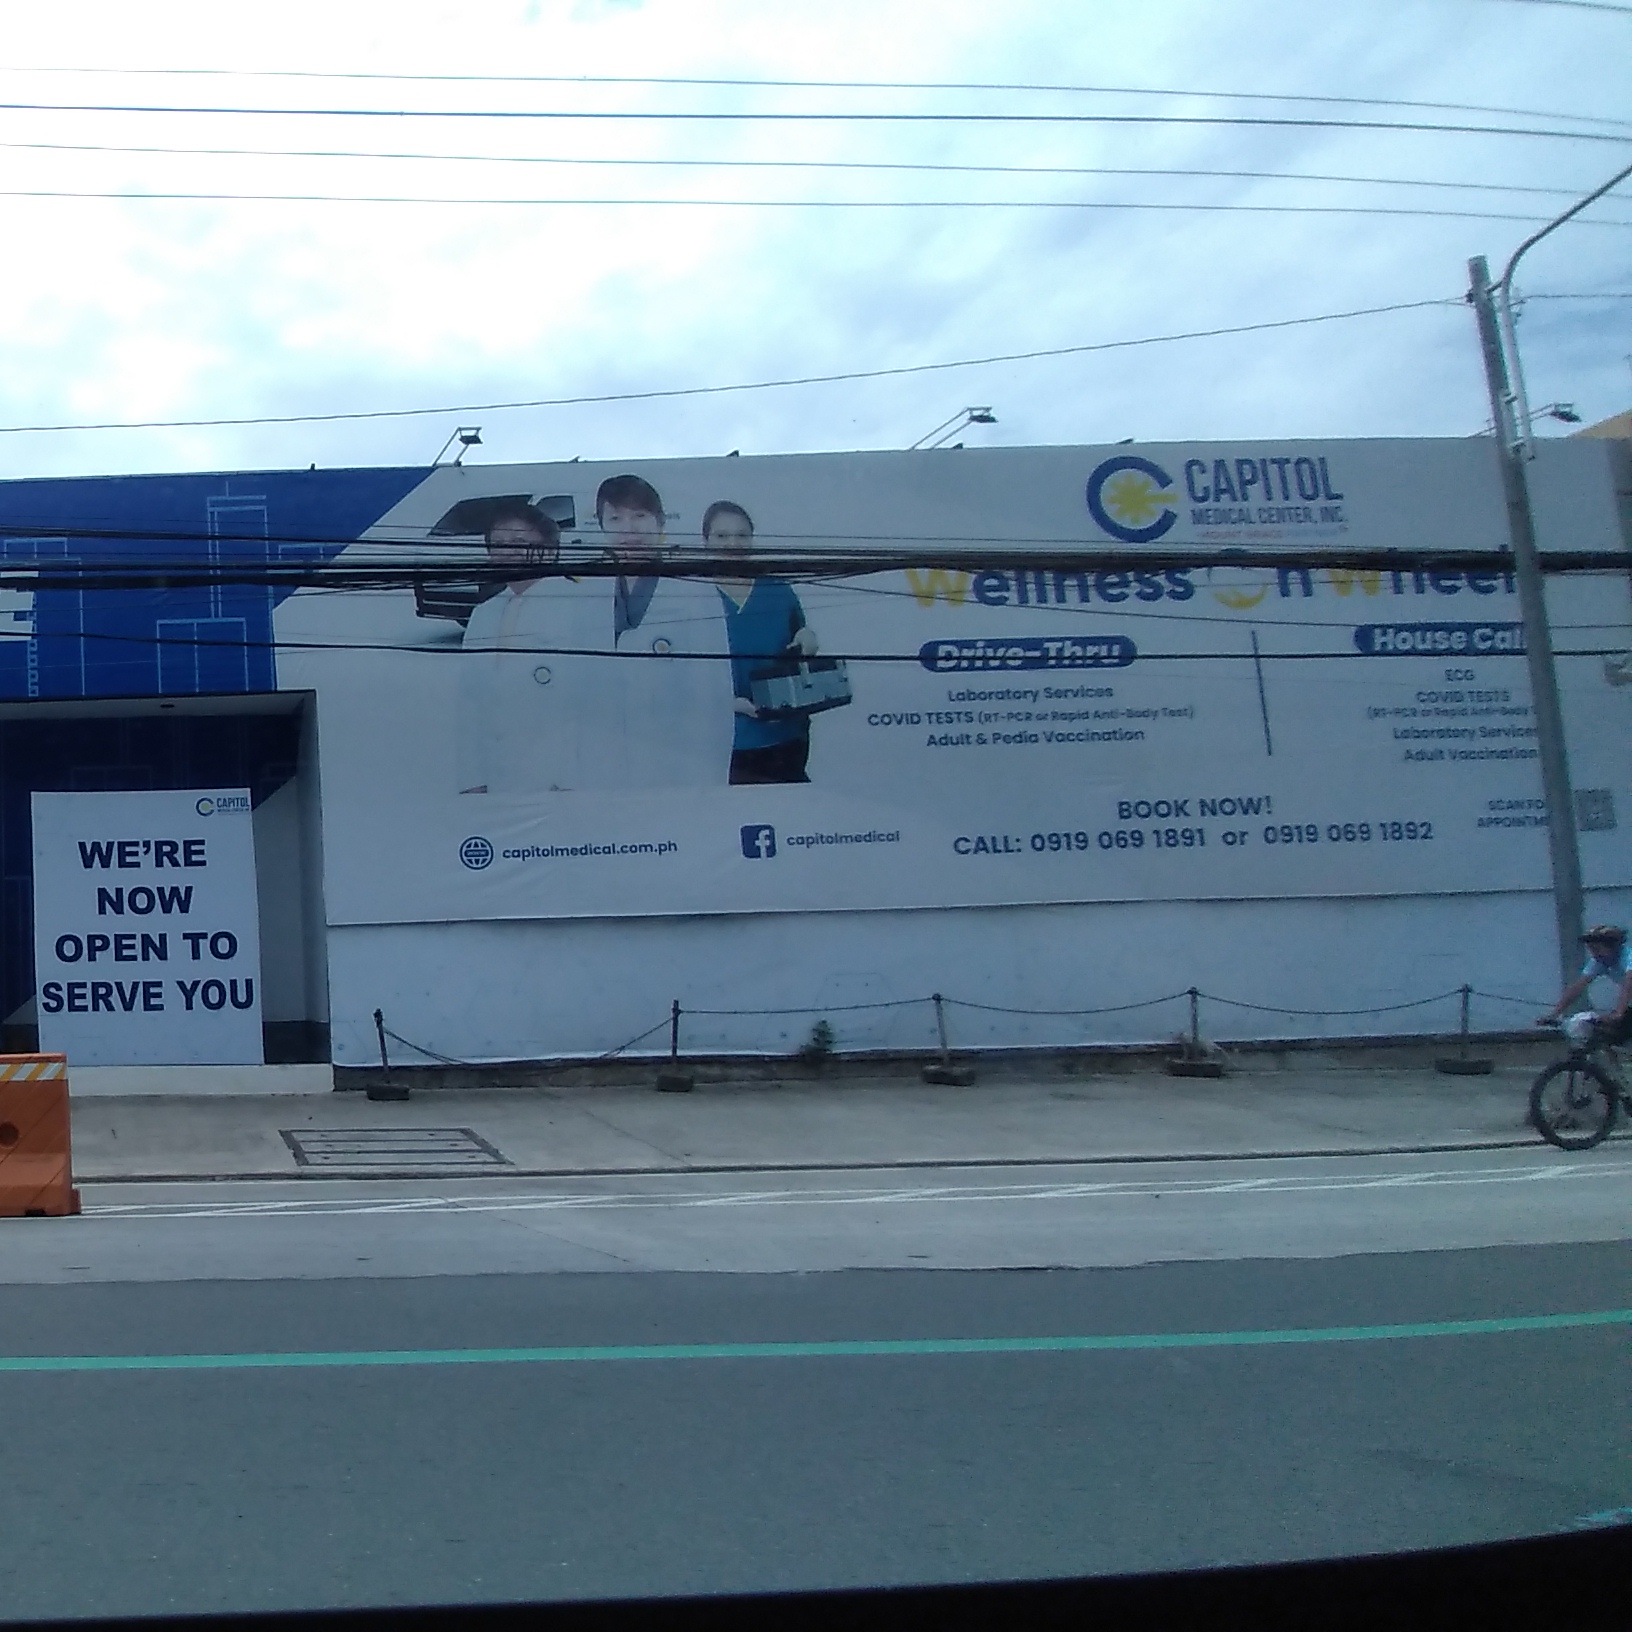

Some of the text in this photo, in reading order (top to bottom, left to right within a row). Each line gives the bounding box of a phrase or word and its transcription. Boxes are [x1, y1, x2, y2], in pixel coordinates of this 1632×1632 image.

[1185, 457, 1344, 503] CAPITOL
[1190, 507, 1256, 525] MEDICAL
[908, 566, 1196, 607] Wellness
[1372, 628, 1468, 650] House
[936, 641, 1121, 669] Drive-Thru
[1443, 668, 1475, 681] ECG
[948, 685, 1113, 704] Laboratory Services
[1415, 689, 1510, 703] COVID TESTS
[868, 713, 921, 727] COVID
[925, 710, 974, 725] TESTS
[1050, 708, 1089, 723] Rapid
[927, 727, 1145, 747] Adult & Pedia Vaccination
[1392, 726, 1475, 741] Laboratory
[1405, 746, 1538, 761] Adult Vaccination
[217, 797, 250, 808] CAPITOL
[1117, 795, 1273, 820] BOOK NOW!
[785, 830, 900, 849] capitolmedical
[953, 820, 1434, 856] CALL: 0919 069 1891 or 0919 069 1892
[502, 840, 678, 862] capitolmedical.com.ph
[97, 886, 193, 915] NOW
[55, 931, 238, 962] OPEN TO
[42, 978, 254, 1013] SERVE YOU
